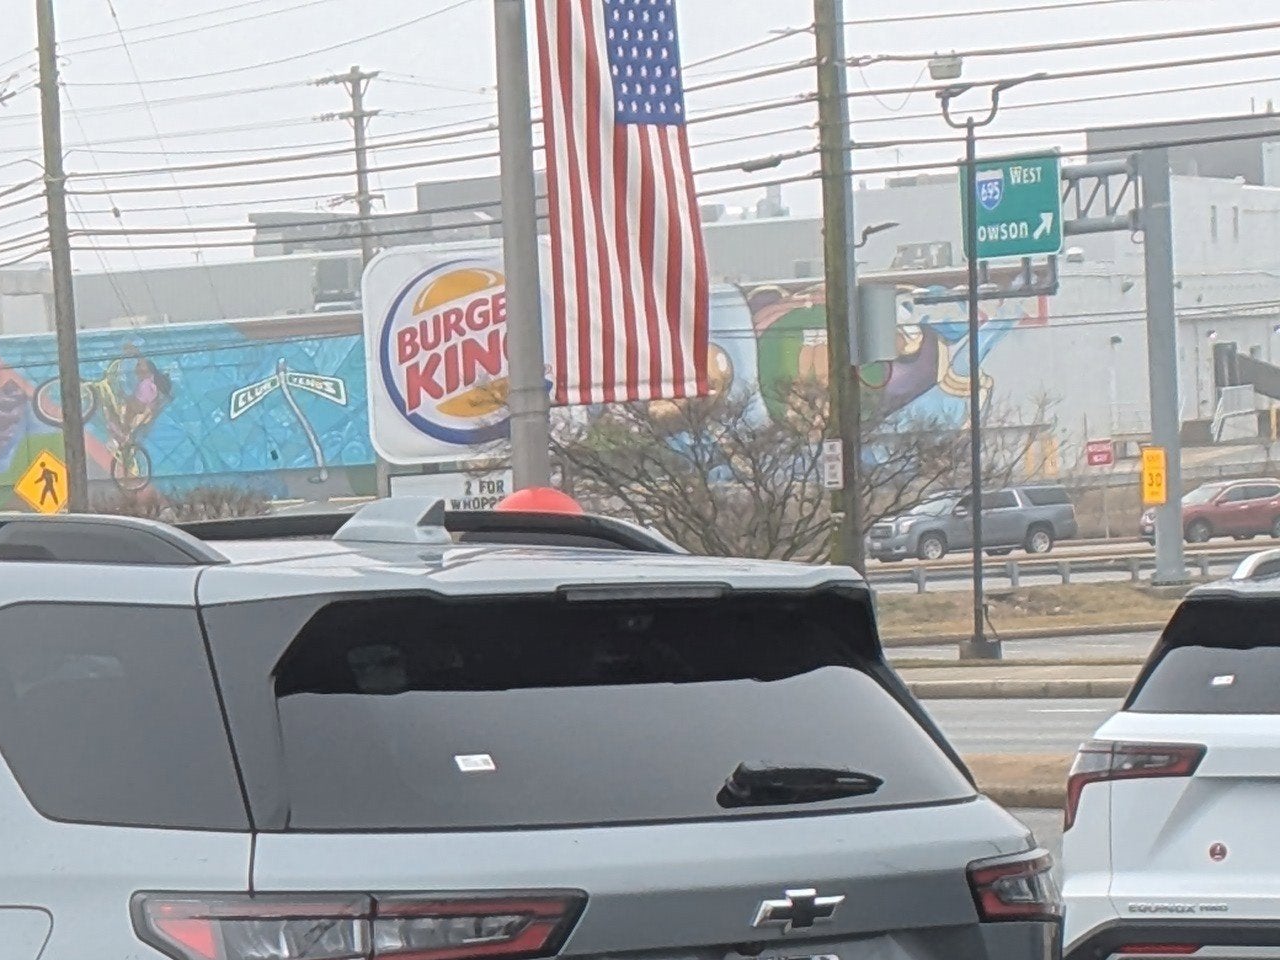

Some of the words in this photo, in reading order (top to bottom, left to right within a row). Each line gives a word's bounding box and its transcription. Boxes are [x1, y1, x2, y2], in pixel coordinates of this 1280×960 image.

[1009, 166, 1042, 185] WEST
[981, 181, 1001, 202] 695
[977, 221, 1029, 242] owson
[397, 291, 507, 365] BURGE
[406, 328, 509, 411] KIN
[464, 480, 472, 496] 2
[480, 480, 504, 494] FOR
[451, 496, 506, 510] WHOPP
